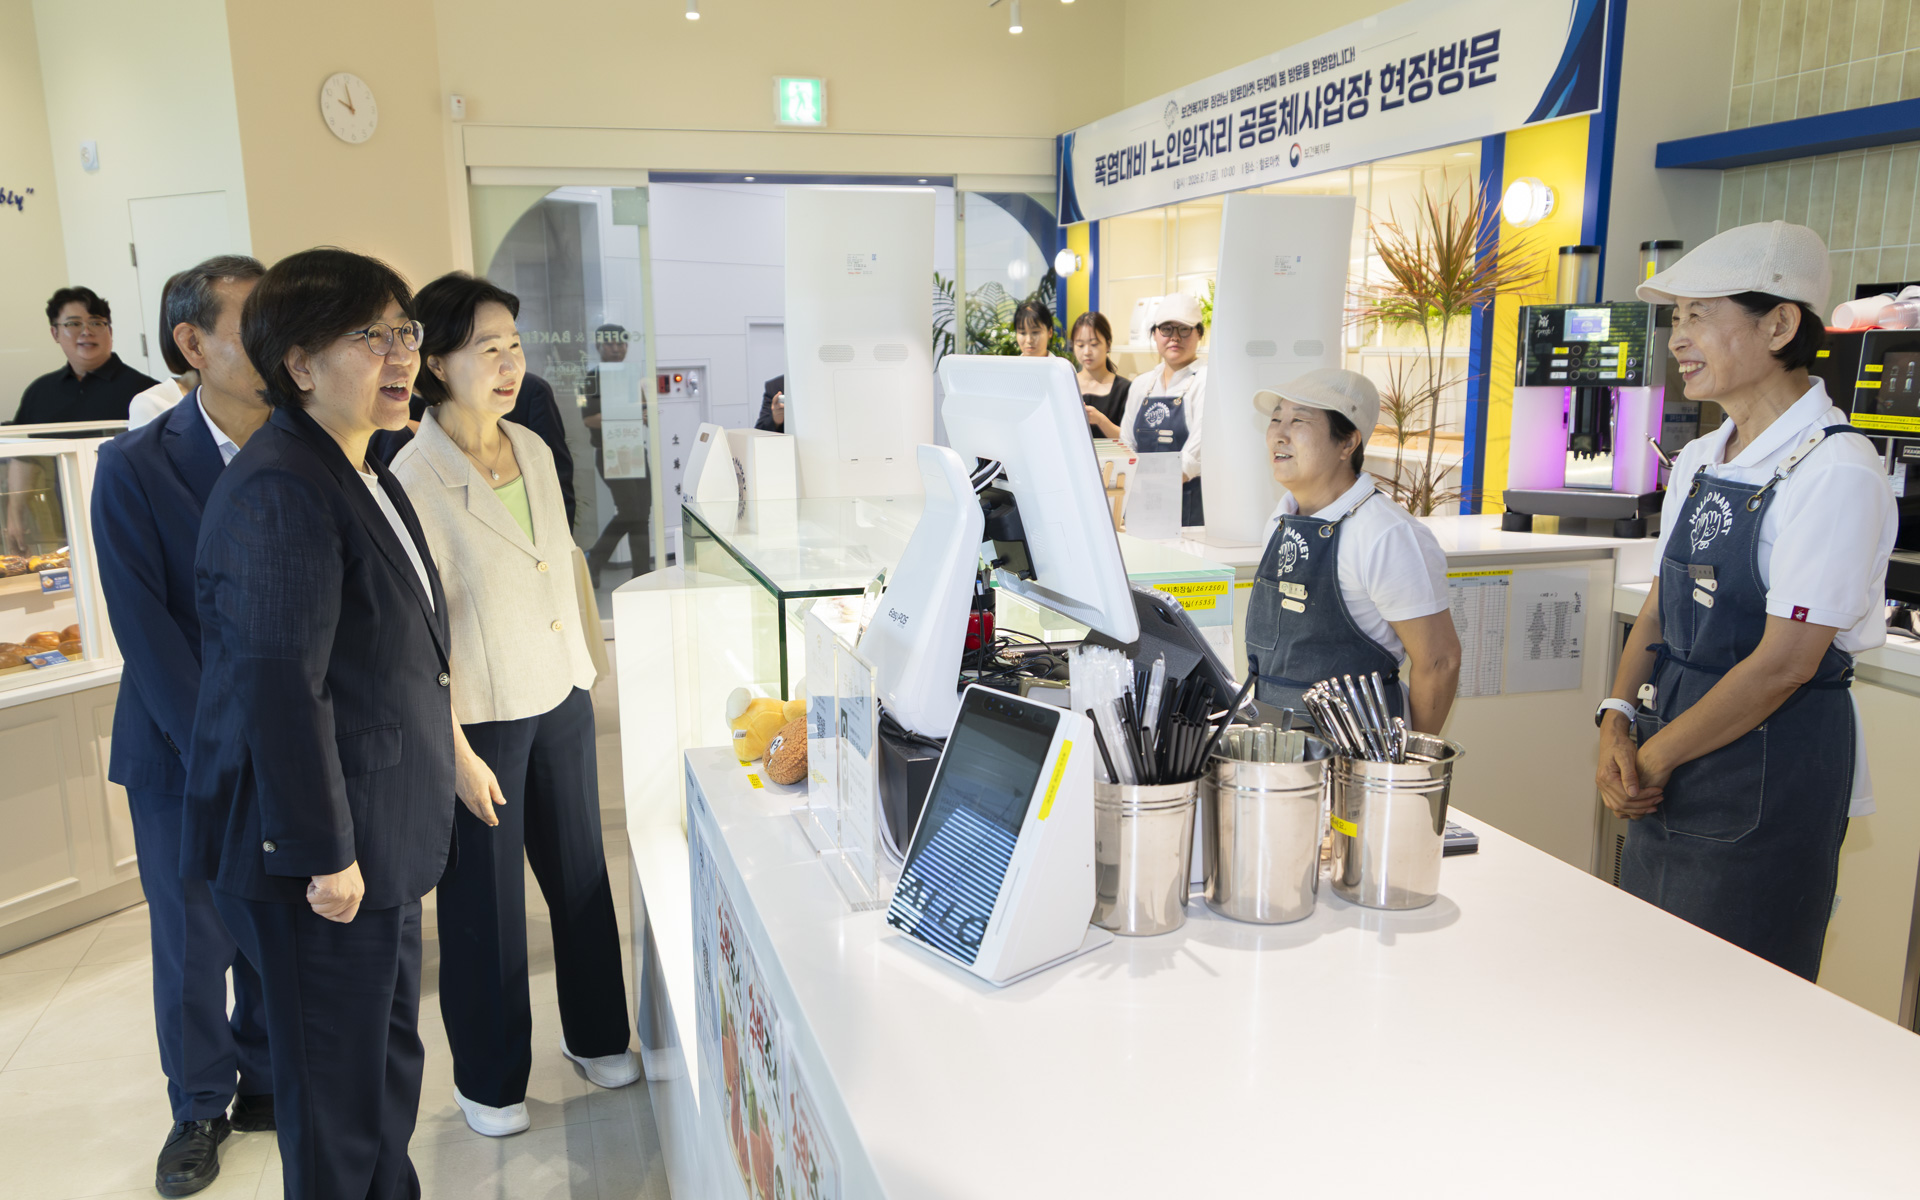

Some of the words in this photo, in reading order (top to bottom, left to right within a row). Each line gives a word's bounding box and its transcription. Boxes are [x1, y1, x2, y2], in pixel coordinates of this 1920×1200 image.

[1094, 141, 1147, 187] 폭염대비
[1150, 113, 1233, 172] 노인일자리
[1238, 69, 1373, 149] 공동체사업장
[1380, 28, 1501, 112] 현장방문
[1181, 97, 1209, 119] 보건복지부
[1211, 91, 1229, 113] 장관님
[1257, 72, 1278, 93] 두번째
[1287, 61, 1311, 83] 방문을
[1312, 46, 1356, 76] 환영합니다!
[1712, 491, 1733, 536] MARKET
